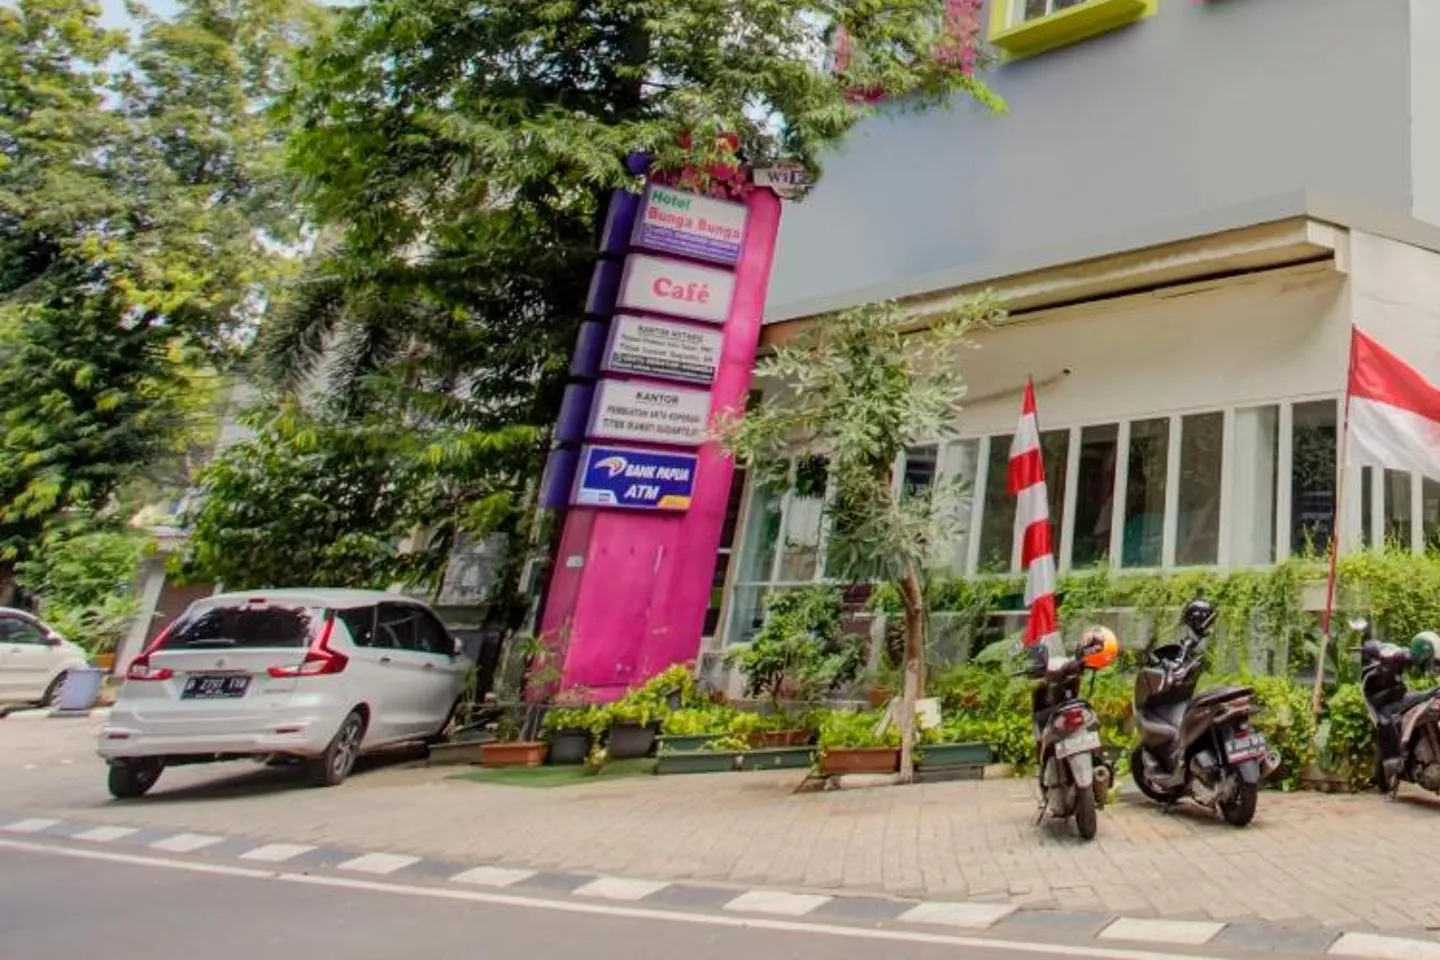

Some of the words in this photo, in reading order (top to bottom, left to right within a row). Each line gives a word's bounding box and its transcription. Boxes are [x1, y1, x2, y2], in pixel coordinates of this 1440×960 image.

[652, 190, 692, 211] Hotel
[647, 206, 694, 230] Bunga
[697, 218, 741, 240] Bunga
[653, 277, 709, 303] Café
[635, 391, 679, 405] KANTOR
[625, 463, 657, 479] BANK
[656, 466, 691, 482] PAPUA
[624, 484, 660, 500] ATM
